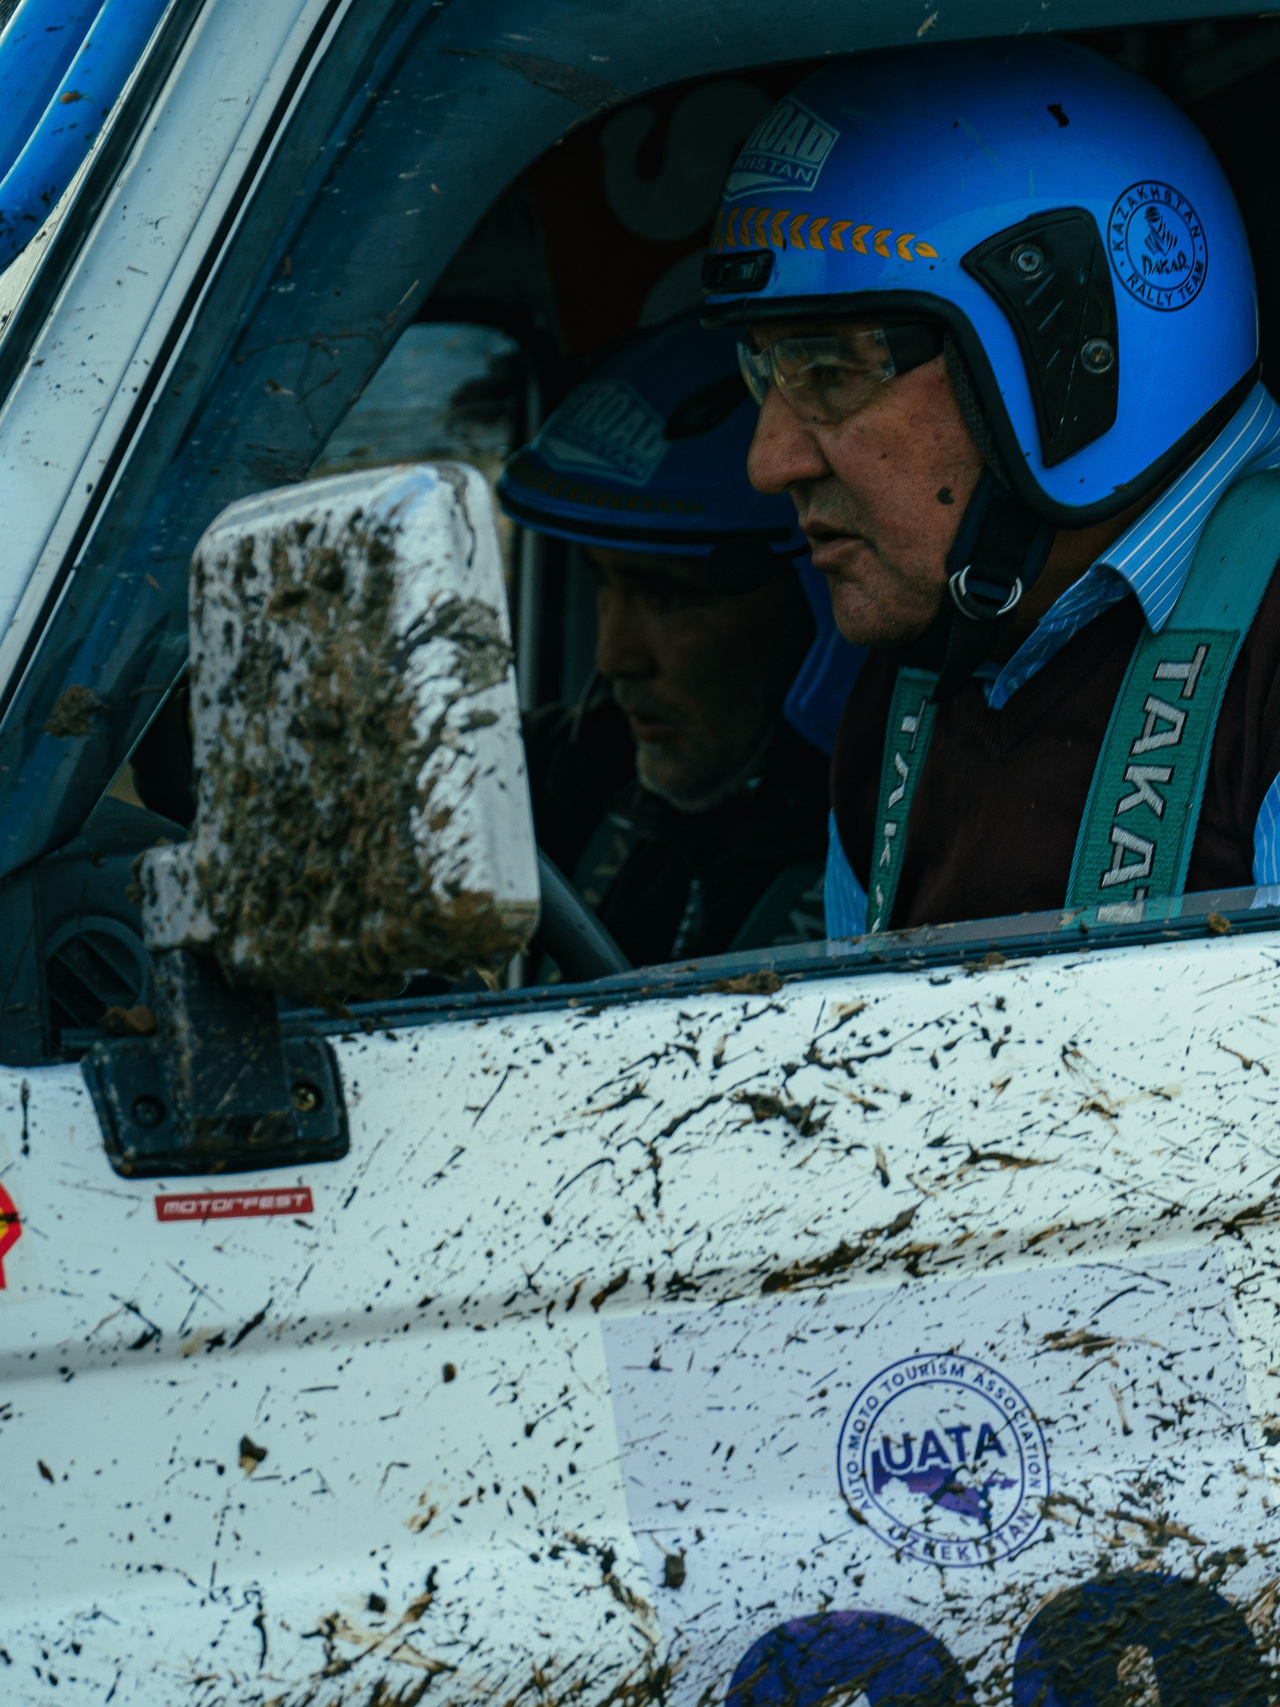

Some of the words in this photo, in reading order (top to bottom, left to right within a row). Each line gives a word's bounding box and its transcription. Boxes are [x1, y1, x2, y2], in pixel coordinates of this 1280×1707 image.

[1126, 272, 1172, 307] RALLY
[1178, 259, 1204, 301] TEAM
[1141, 250, 1191, 276] DAKAR
[846, 1395, 880, 1511] AUTO-MOTO
[882, 1363, 966, 1393] TOURISM
[973, 1370, 1043, 1490] ASSOCIATION
[881, 1421, 1008, 1471] UATA
